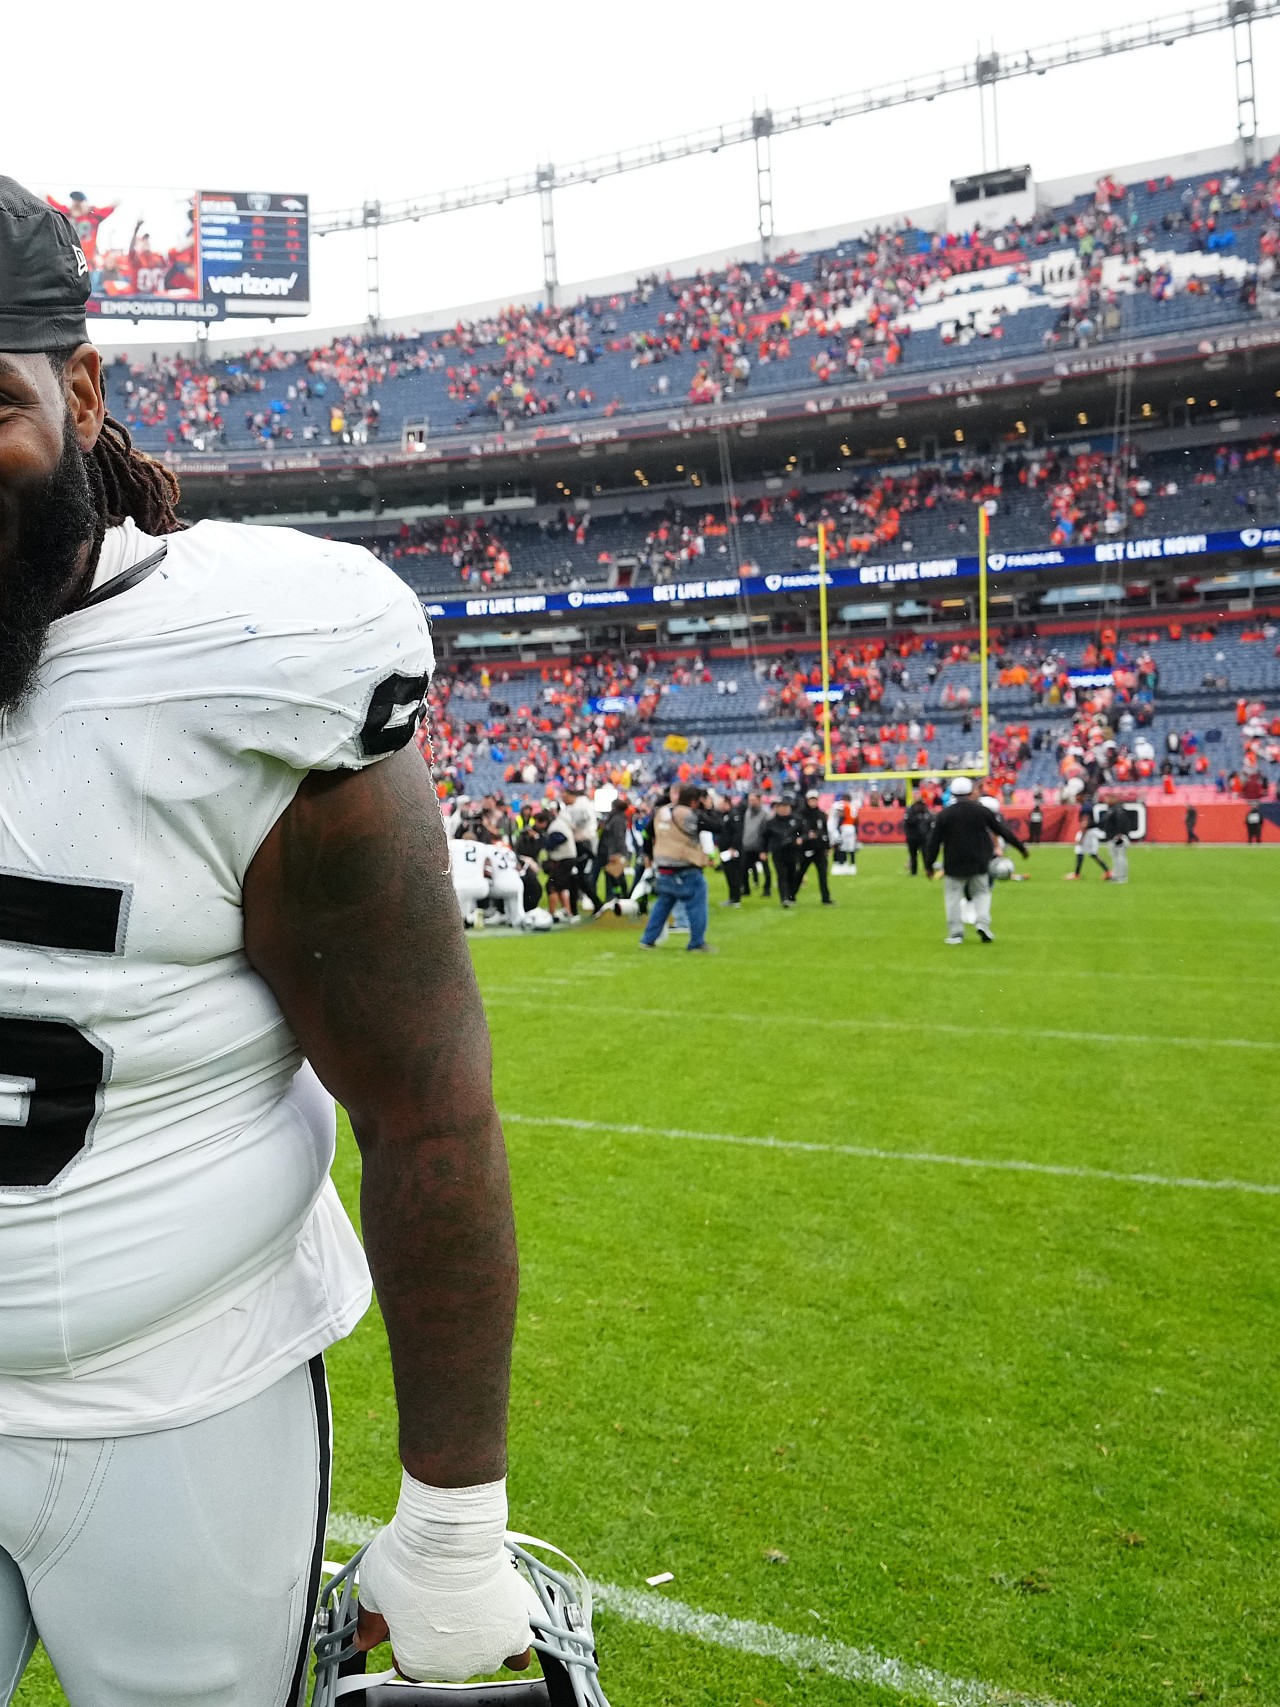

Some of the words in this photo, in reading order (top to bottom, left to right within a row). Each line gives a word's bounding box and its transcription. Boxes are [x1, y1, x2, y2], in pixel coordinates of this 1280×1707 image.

[208, 272, 289, 295] verizon
[100, 301, 176, 316] EMPOWER
[176, 302, 219, 317] FIELD
[1094, 542, 1124, 562] BET
[1126, 538, 1162, 560] LIVE
[1163, 534, 1207, 555] NOW!
[1006, 551, 1065, 568] FANDUEL
[859, 566, 886, 584] BET
[887, 562, 919, 582] LIVE
[919, 558, 958, 578] NOW!
[652, 584, 677, 602] BET
[678, 581, 707, 600] LIVE
